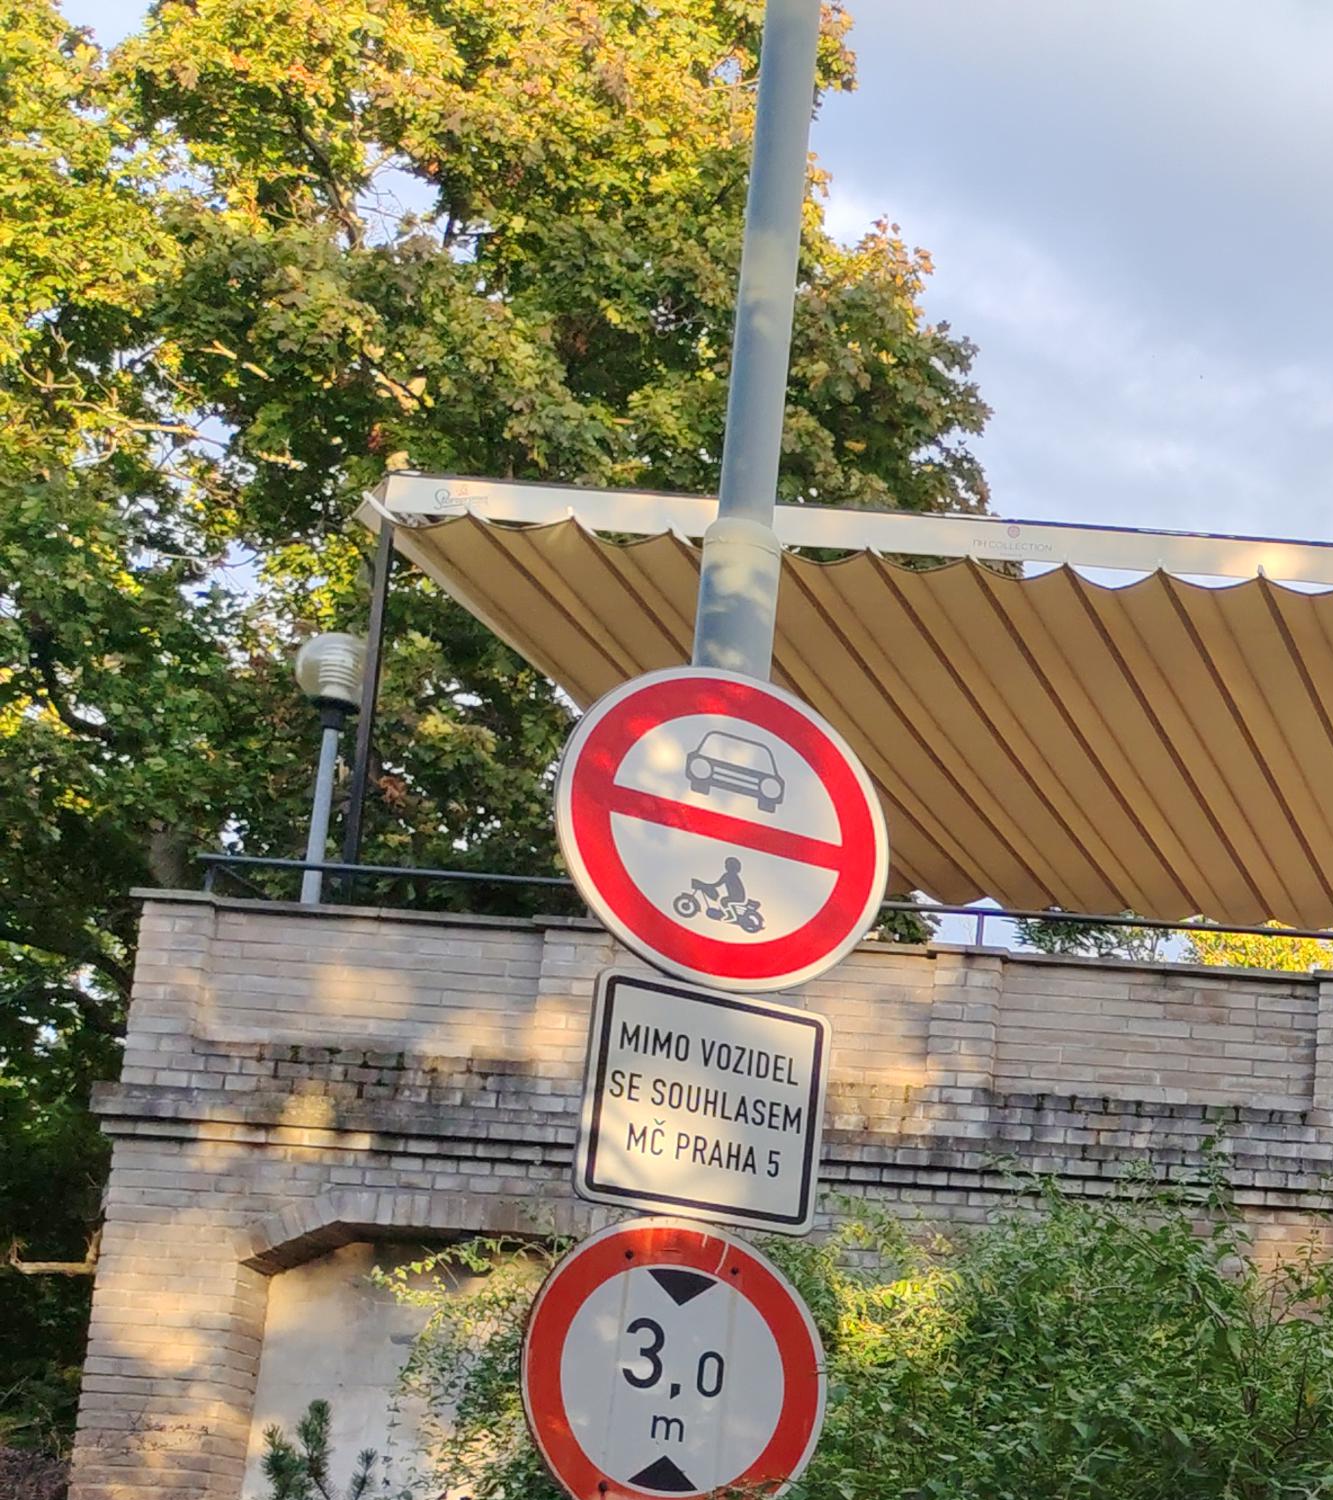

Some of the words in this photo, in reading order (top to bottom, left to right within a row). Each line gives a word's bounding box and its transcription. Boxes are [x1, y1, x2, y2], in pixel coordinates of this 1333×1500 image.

[619, 1021, 690, 1062] MIMO
[700, 1037, 799, 1086] VOZIDEL
[608, 1069, 642, 1102] SE
[650, 1078, 802, 1135] SOUHLASEM
[626, 1117, 667, 1156] MČ
[674, 1132, 757, 1175] PRAHA
[766, 1150, 781, 1178] 5
[622, 1317, 725, 1400] 3,0
[650, 1414, 685, 1443] m
